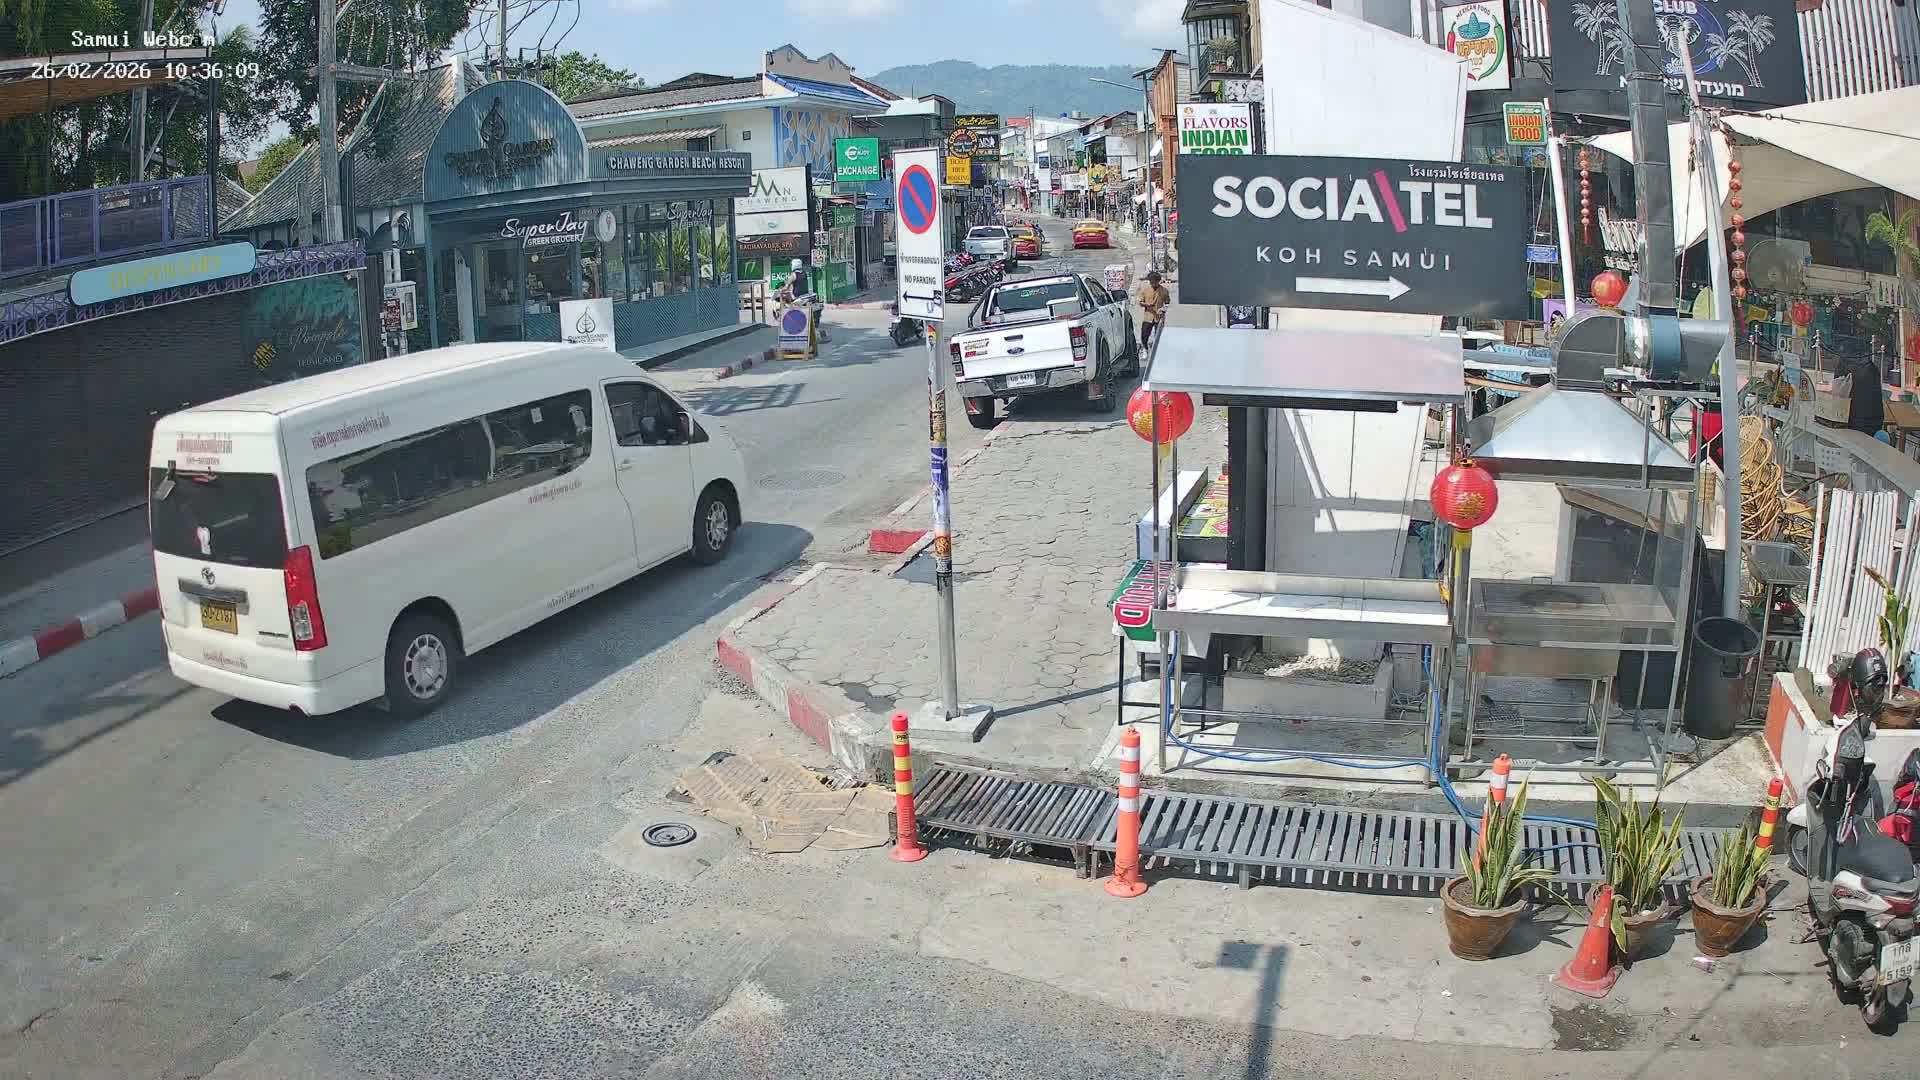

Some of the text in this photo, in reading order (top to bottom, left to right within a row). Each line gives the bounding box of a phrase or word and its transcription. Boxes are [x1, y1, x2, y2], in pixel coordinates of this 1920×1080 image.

[1456, 4, 1491, 18] MEXICAN FOOD
[1183, 117, 1248, 129] FLAVORS
[1508, 114, 1542, 127] INDIAN
[1181, 130, 1248, 147] INDIAN
[1511, 127, 1542, 140] FOOD
[609, 155, 746, 170] CHAWENG GARDEN BEACH RESORT
[837, 165, 879, 176] EXCHANGE
[527, 232, 581, 246] GREEN GROCER
[1256, 246, 1451, 272] KOH SAMUI
[109, 255, 222, 292] DISPENSARY
[771, 271, 790, 281] EXCH
[904, 274, 937, 286] NO PARKING
